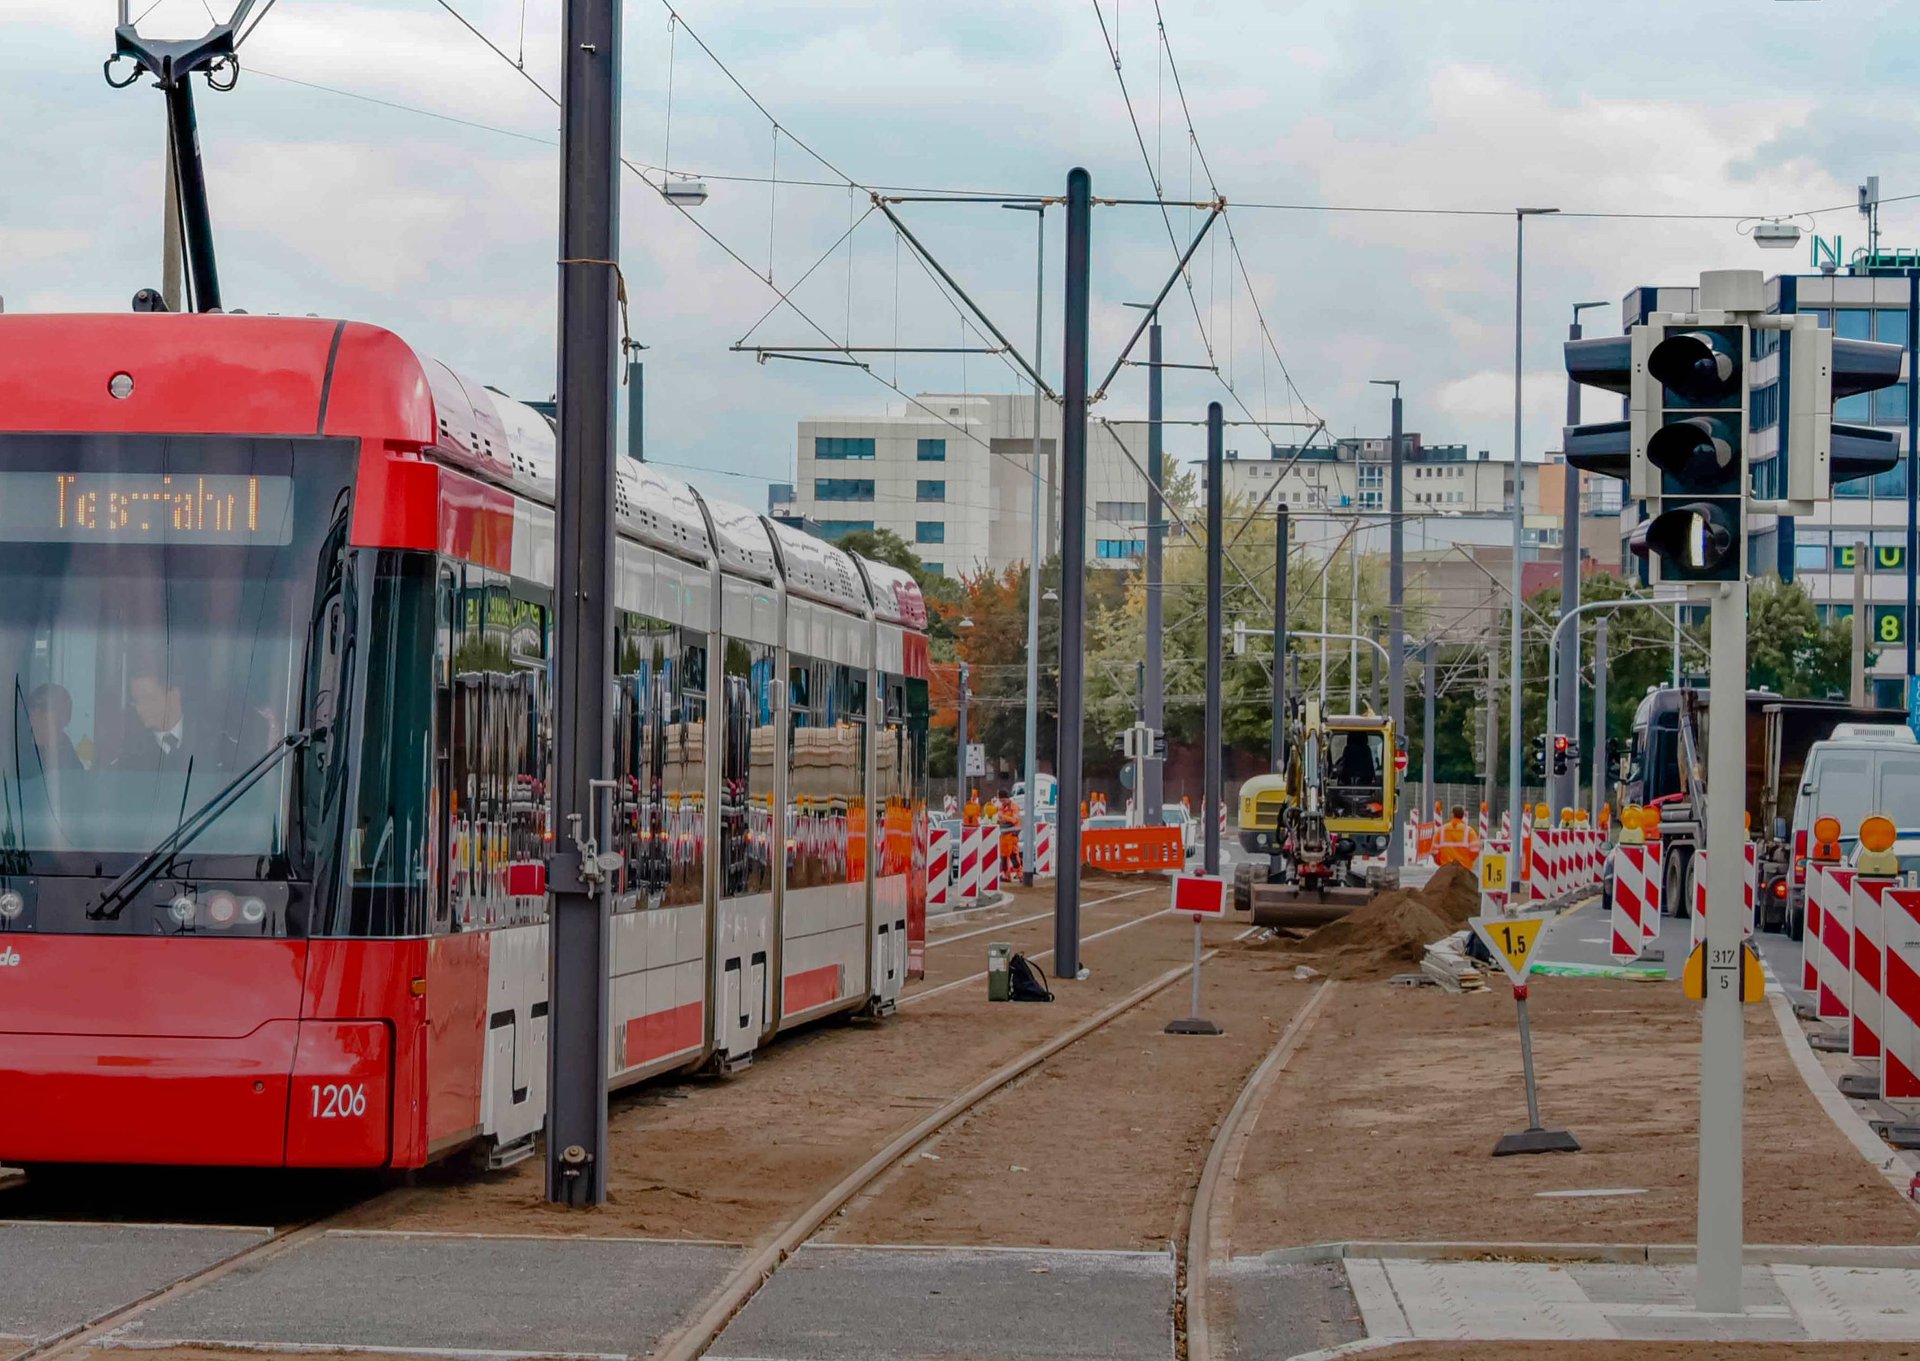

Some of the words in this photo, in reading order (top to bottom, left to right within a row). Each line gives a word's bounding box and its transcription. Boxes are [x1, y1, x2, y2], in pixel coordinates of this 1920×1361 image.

[1486, 863, 1502, 884] 1,5
[1502, 926, 1526, 957] 1,5
[1712, 950, 1735, 964] 317
[1720, 975, 1729, 989] 5
[311, 1083, 366, 1118] 1206
